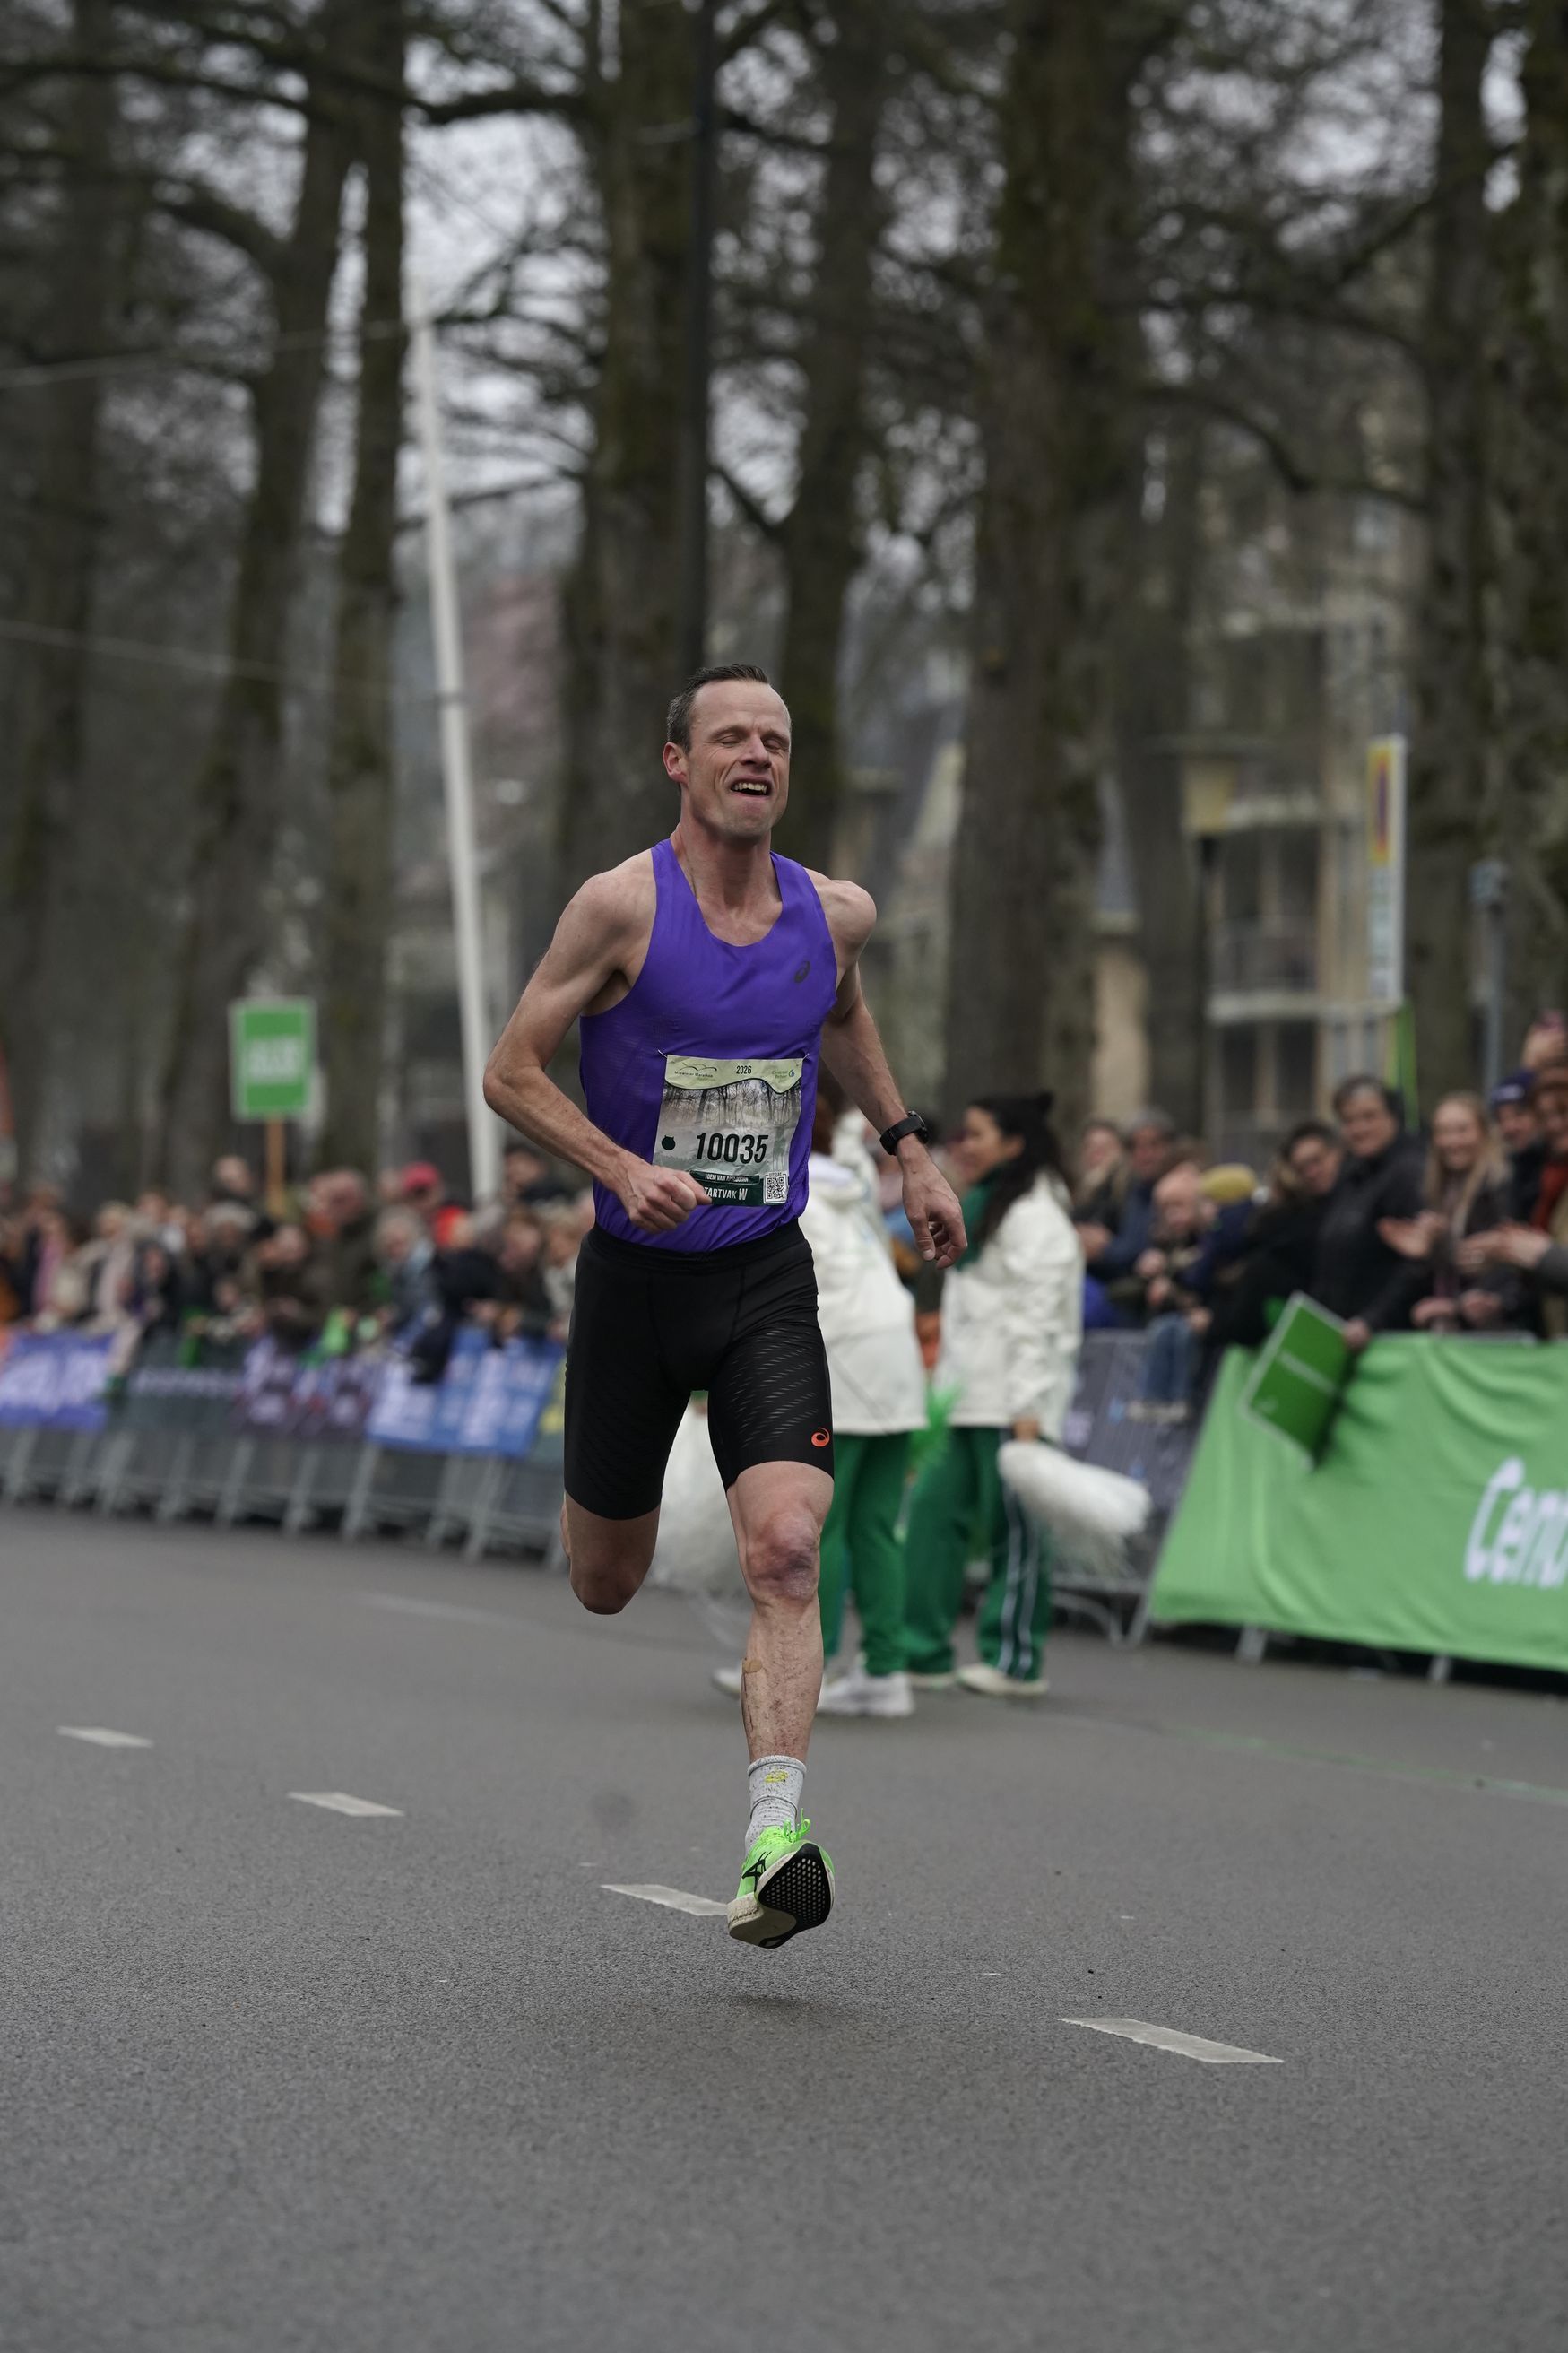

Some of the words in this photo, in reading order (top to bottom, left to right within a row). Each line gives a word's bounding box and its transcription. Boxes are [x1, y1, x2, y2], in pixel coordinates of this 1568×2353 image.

[736, 1065, 752, 1074] 2026
[696, 1132, 769, 1165] 10035
[704, 1187, 738, 1199] TARTVAK
[739, 1188, 748, 1200] W
